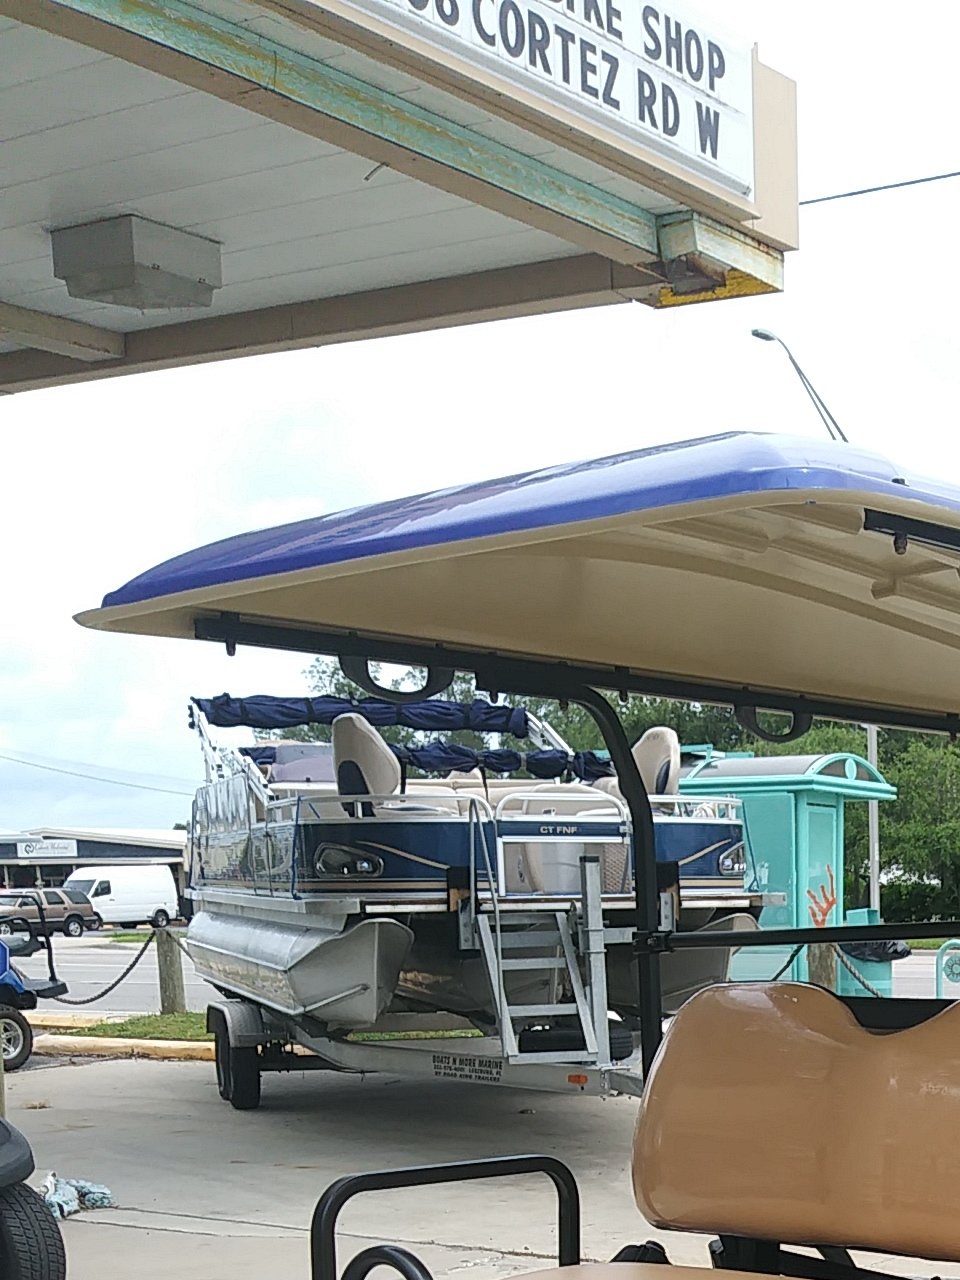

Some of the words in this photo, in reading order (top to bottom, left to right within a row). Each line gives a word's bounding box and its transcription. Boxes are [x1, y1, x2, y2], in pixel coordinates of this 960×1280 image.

[642, 5, 726, 93] SHOP
[472, 0, 621, 112] CORTEZ
[637, 68, 681, 138] RD
[695, 100, 721, 160] W
[432, 1055, 451, 1065] BOATS
[459, 1057, 476, 1067] MORE
[478, 1059, 503, 1070] MARINE
[474, 1074, 501, 1082] TRAILERS
